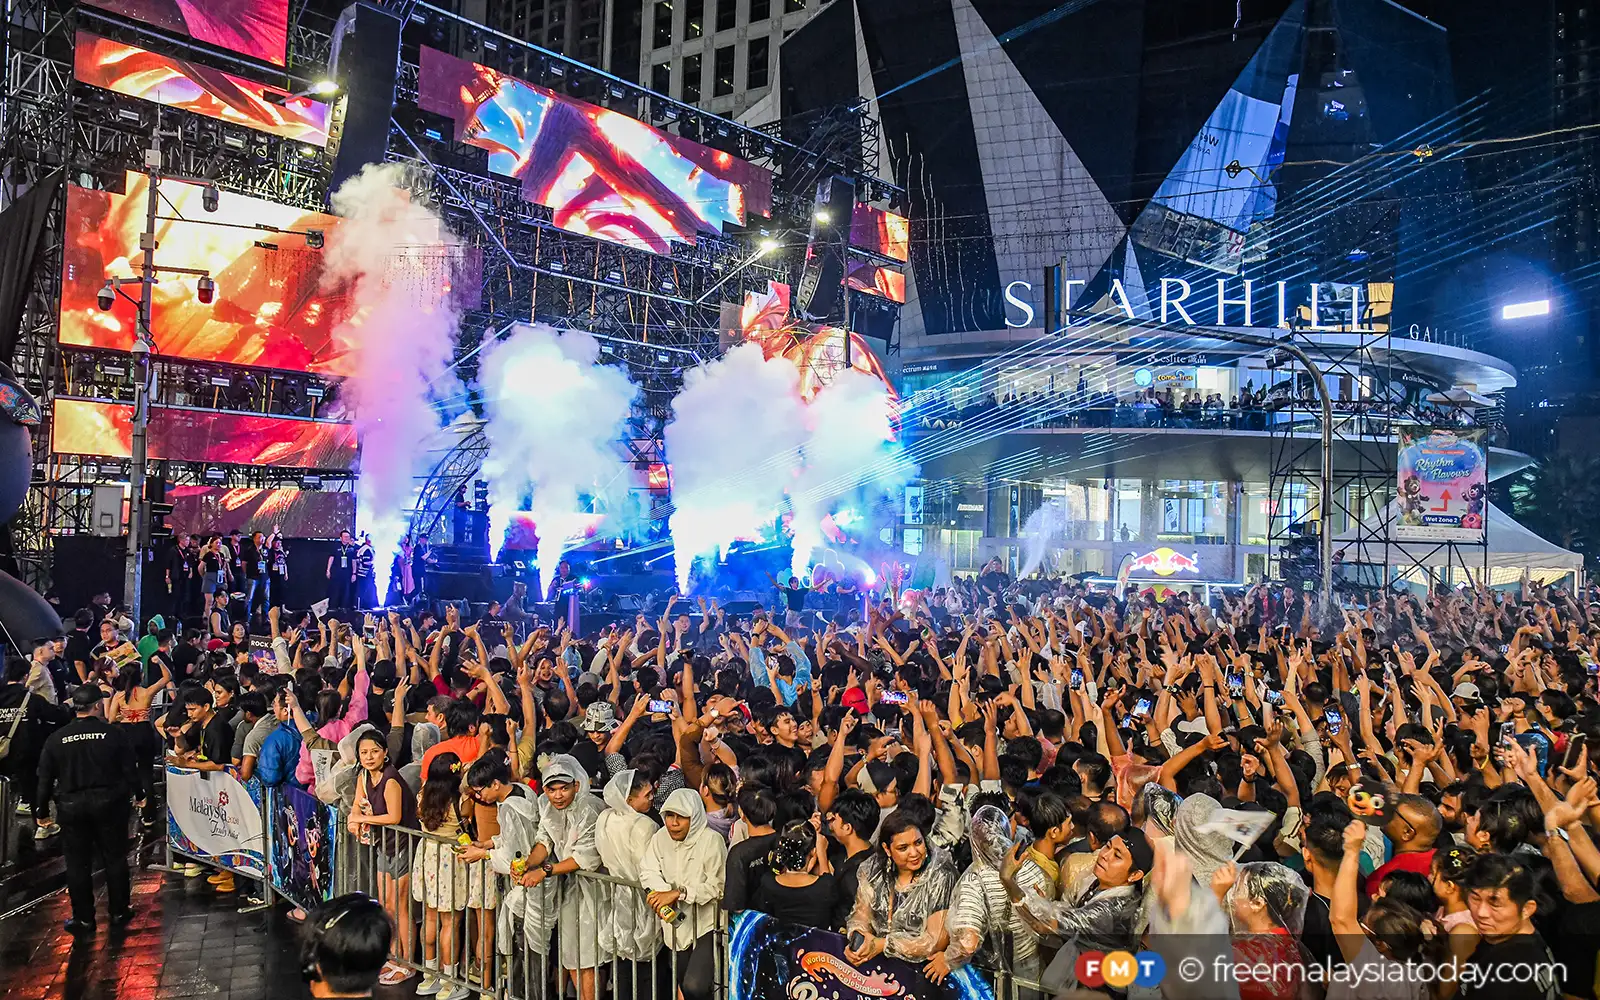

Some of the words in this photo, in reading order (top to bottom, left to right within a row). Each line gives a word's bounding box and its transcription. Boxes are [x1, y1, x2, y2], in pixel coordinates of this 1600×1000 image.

[1004, 278, 1375, 332] STARHILL
[1160, 354, 1186, 363] eslite
[1415, 457, 1454, 471] Rhythm
[1431, 468, 1471, 480] Flavours
[250, 640, 269, 648] ROCK
[62, 732, 107, 744] SECURITY
[189, 796, 227, 821] Malaysia
[805, 955, 826, 966] World
[826, 956, 851, 975] Labour
[851, 972, 867, 985] Day
[838, 973, 883, 995] Celebration
